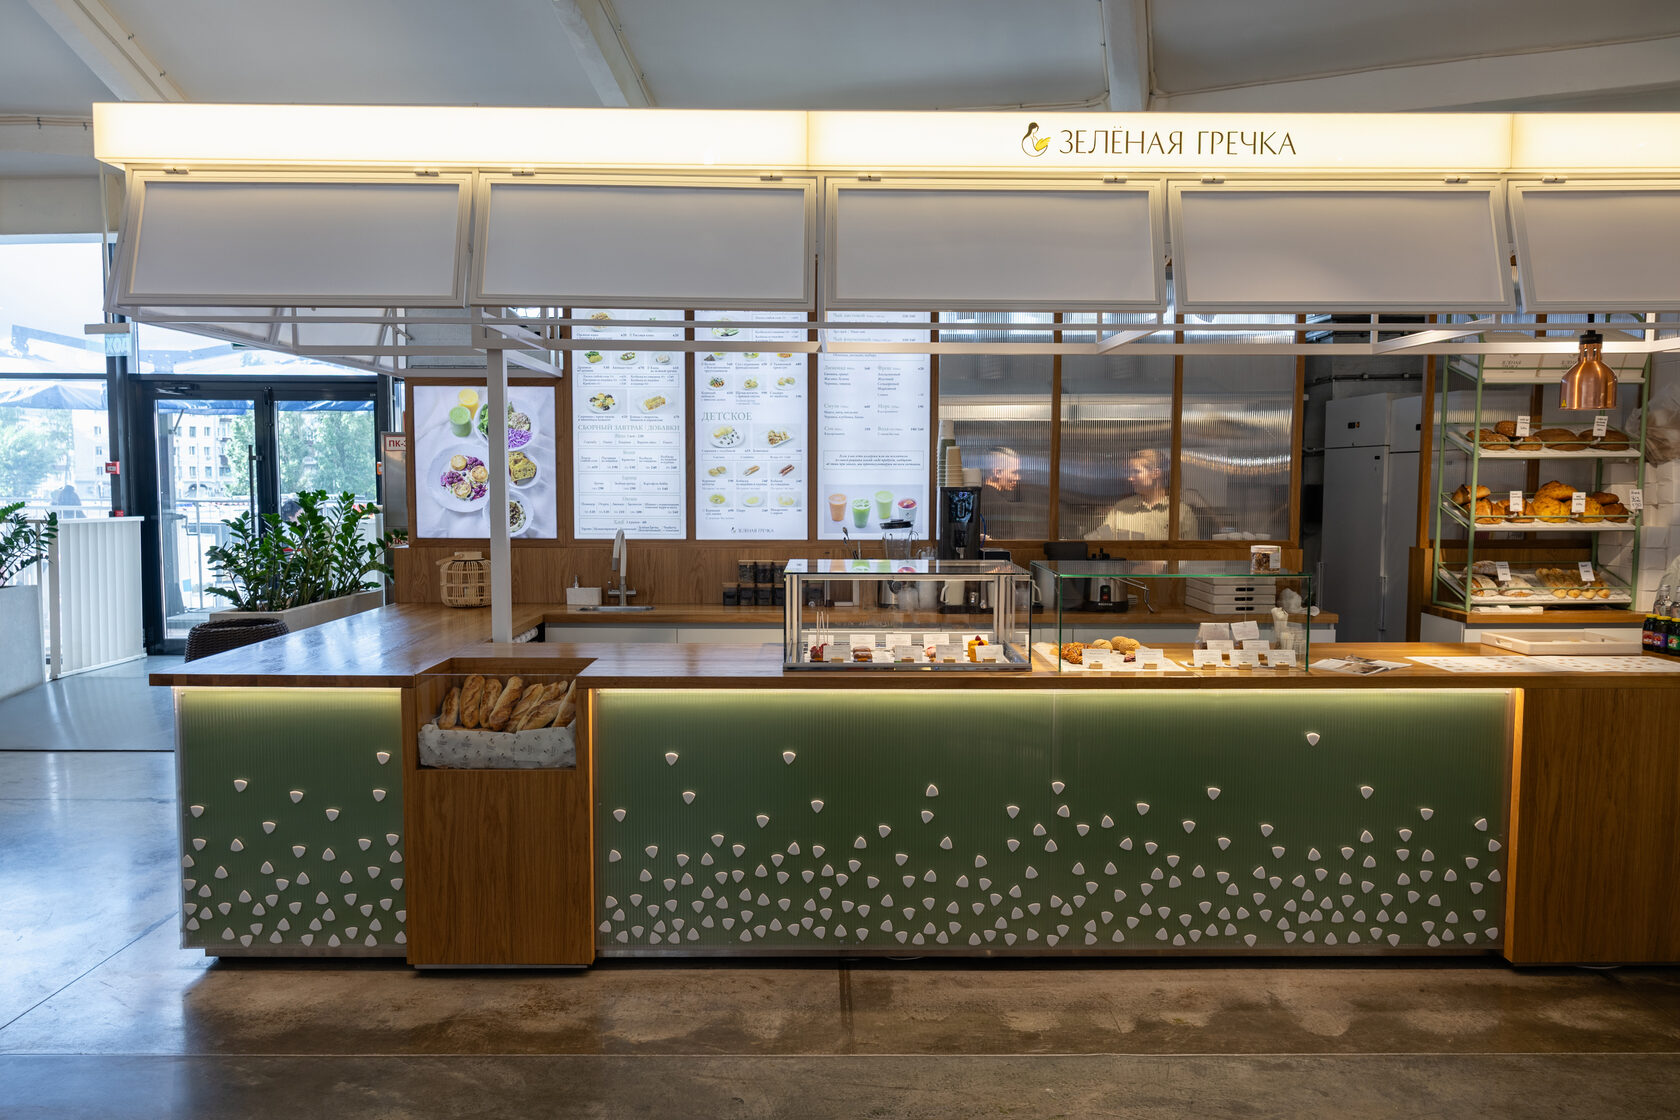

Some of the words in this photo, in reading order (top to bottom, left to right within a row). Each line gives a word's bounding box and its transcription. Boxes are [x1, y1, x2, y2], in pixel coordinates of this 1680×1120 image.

[1059, 125, 1183, 155] ЗЕЛЁНАЯ
[1198, 131, 1297, 155] ГРЕЧКА
[701, 411, 753, 422] ДЕТСКОЕ
